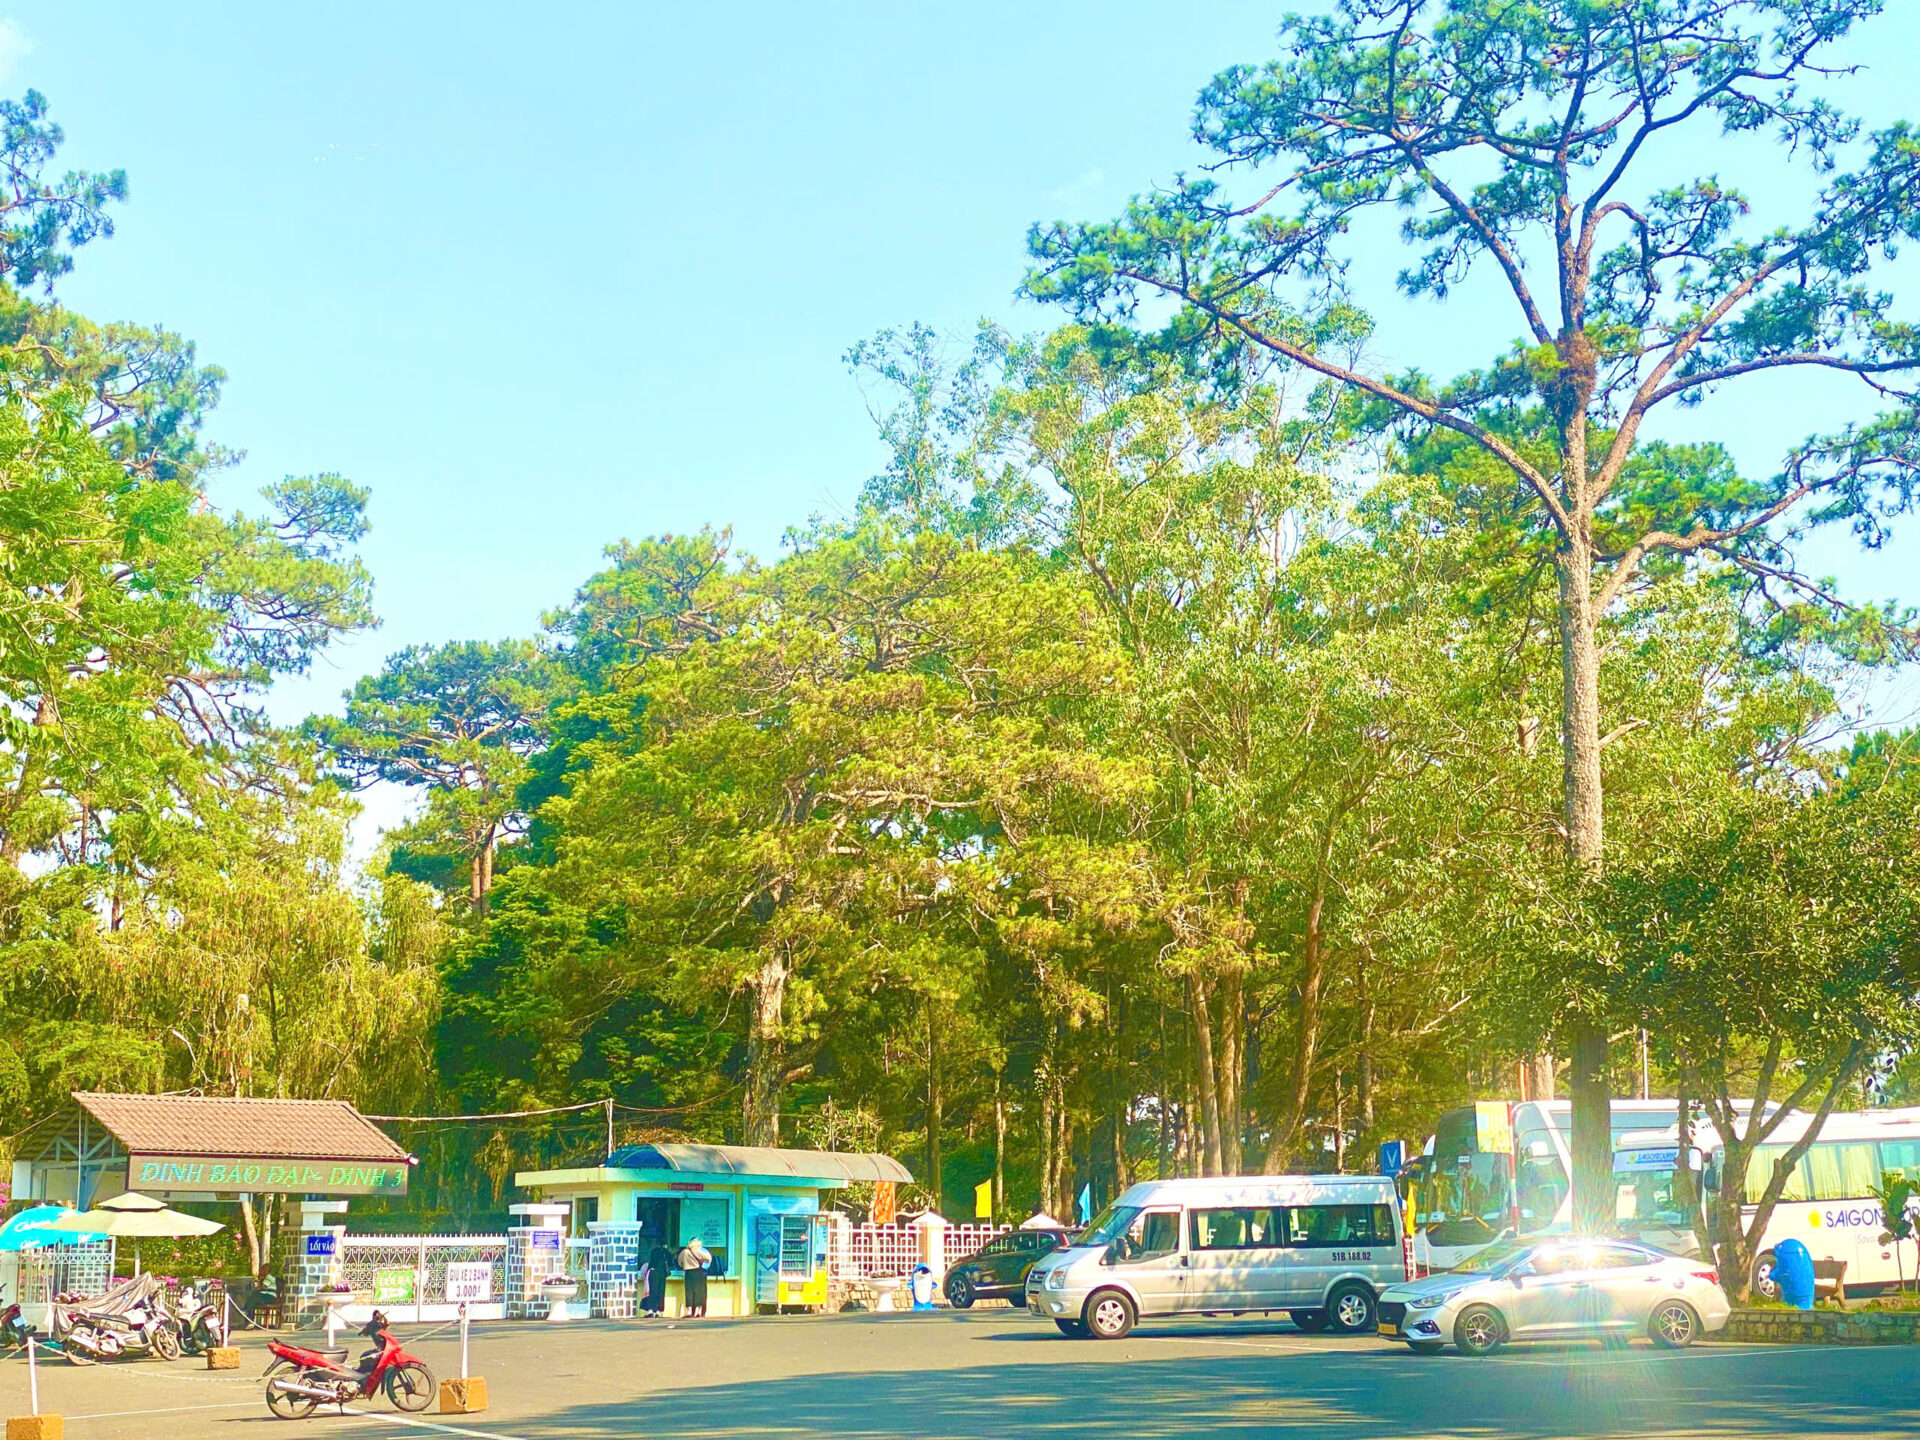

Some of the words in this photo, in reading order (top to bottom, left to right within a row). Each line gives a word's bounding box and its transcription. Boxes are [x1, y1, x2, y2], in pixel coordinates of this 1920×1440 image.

[208, 1159, 261, 1184] BẢO
[327, 1167, 387, 1187] DINH
[391, 1169, 404, 1187] 3
[310, 1239, 321, 1251] LỐI
[322, 1240, 335, 1251] VÀO
[461, 1269, 468, 1281] XE
